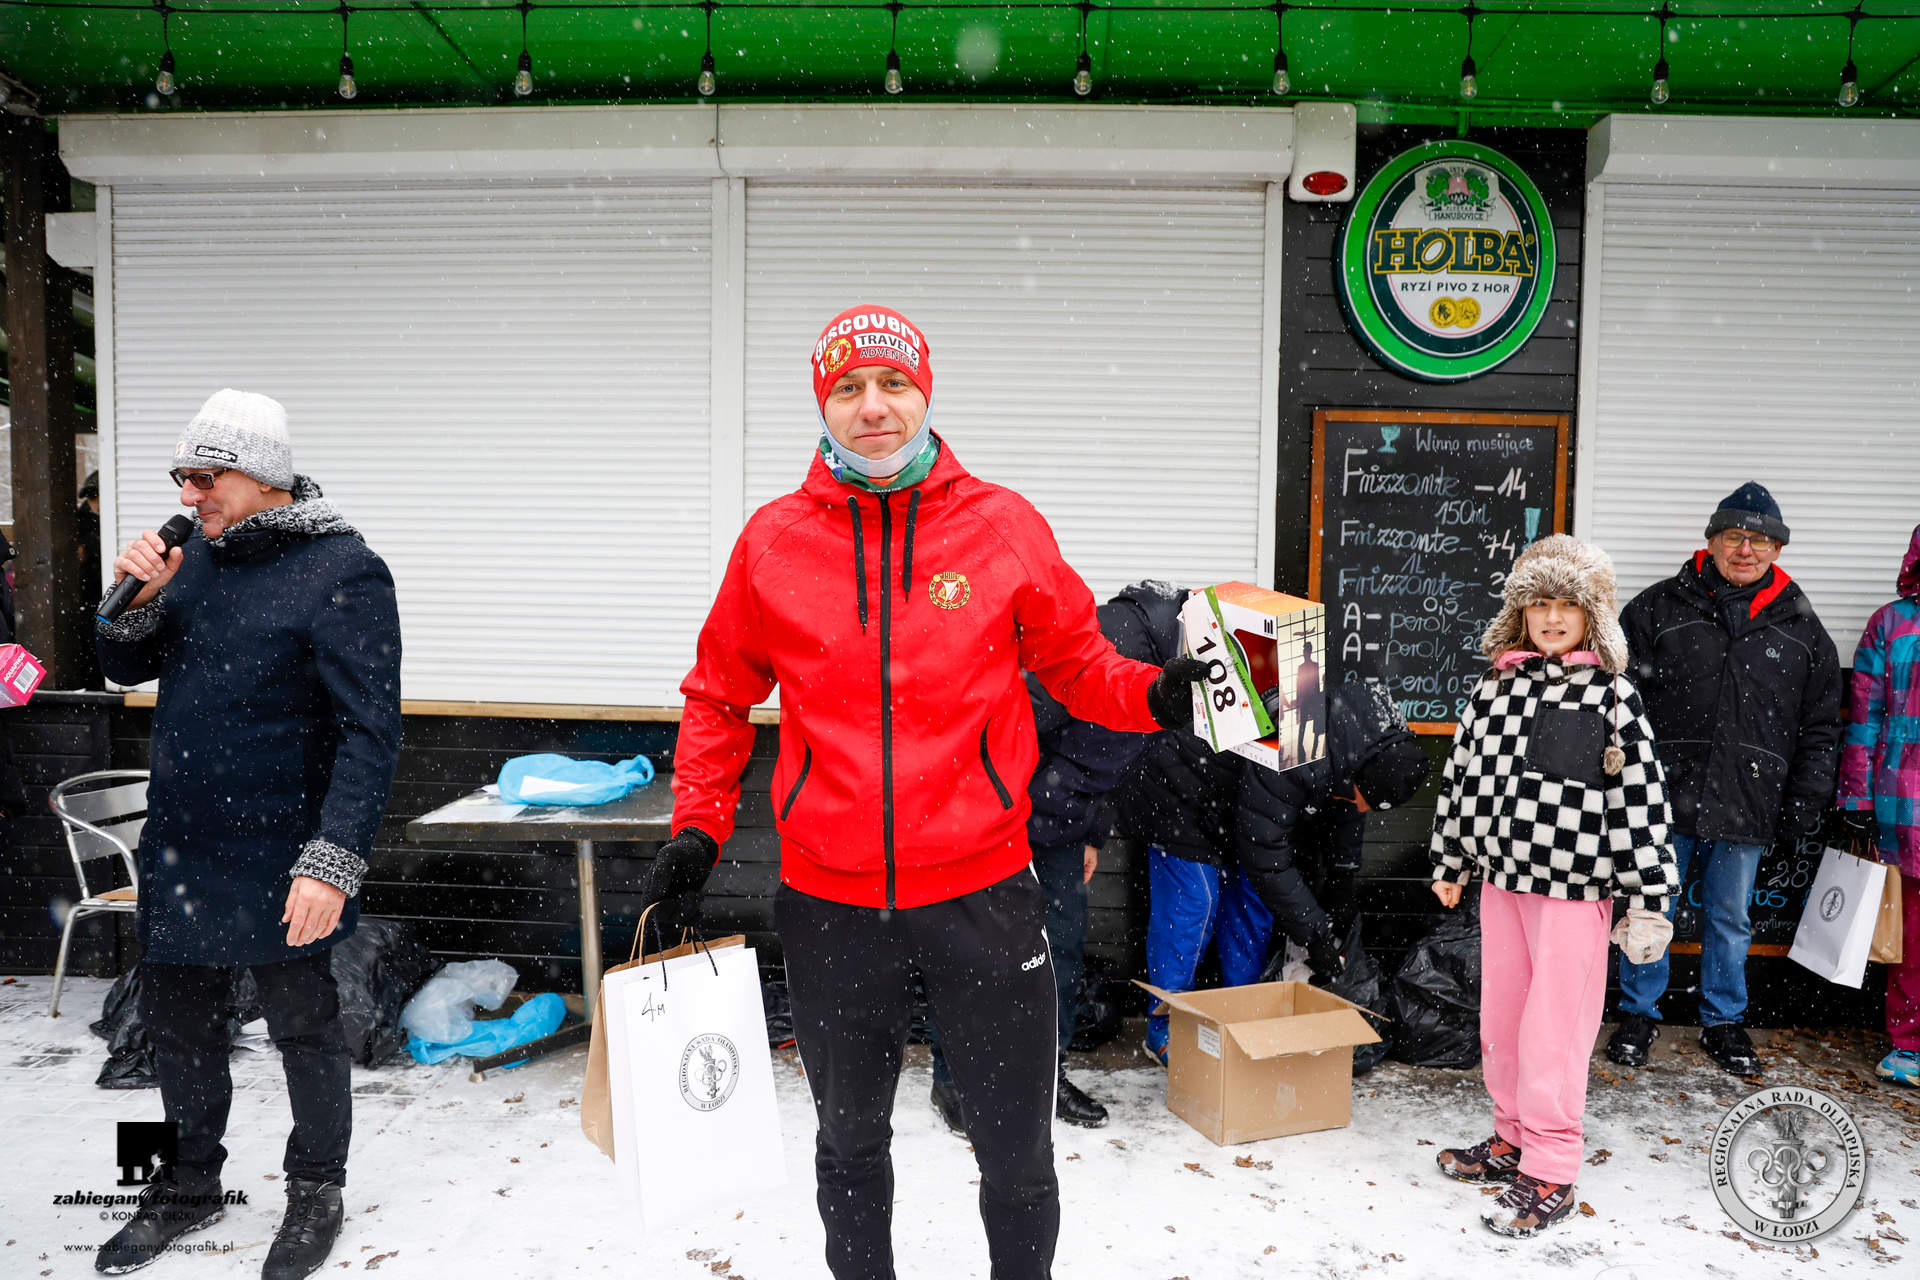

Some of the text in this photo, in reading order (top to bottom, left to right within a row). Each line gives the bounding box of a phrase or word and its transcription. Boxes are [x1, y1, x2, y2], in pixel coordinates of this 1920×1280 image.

[1374, 228, 1534, 277] HOLBA
[1401, 280, 1510, 293] RYZÍ PIVO Z HOR
[858, 335, 909, 355] TRAVEL
[1196, 636, 1236, 712] 108
